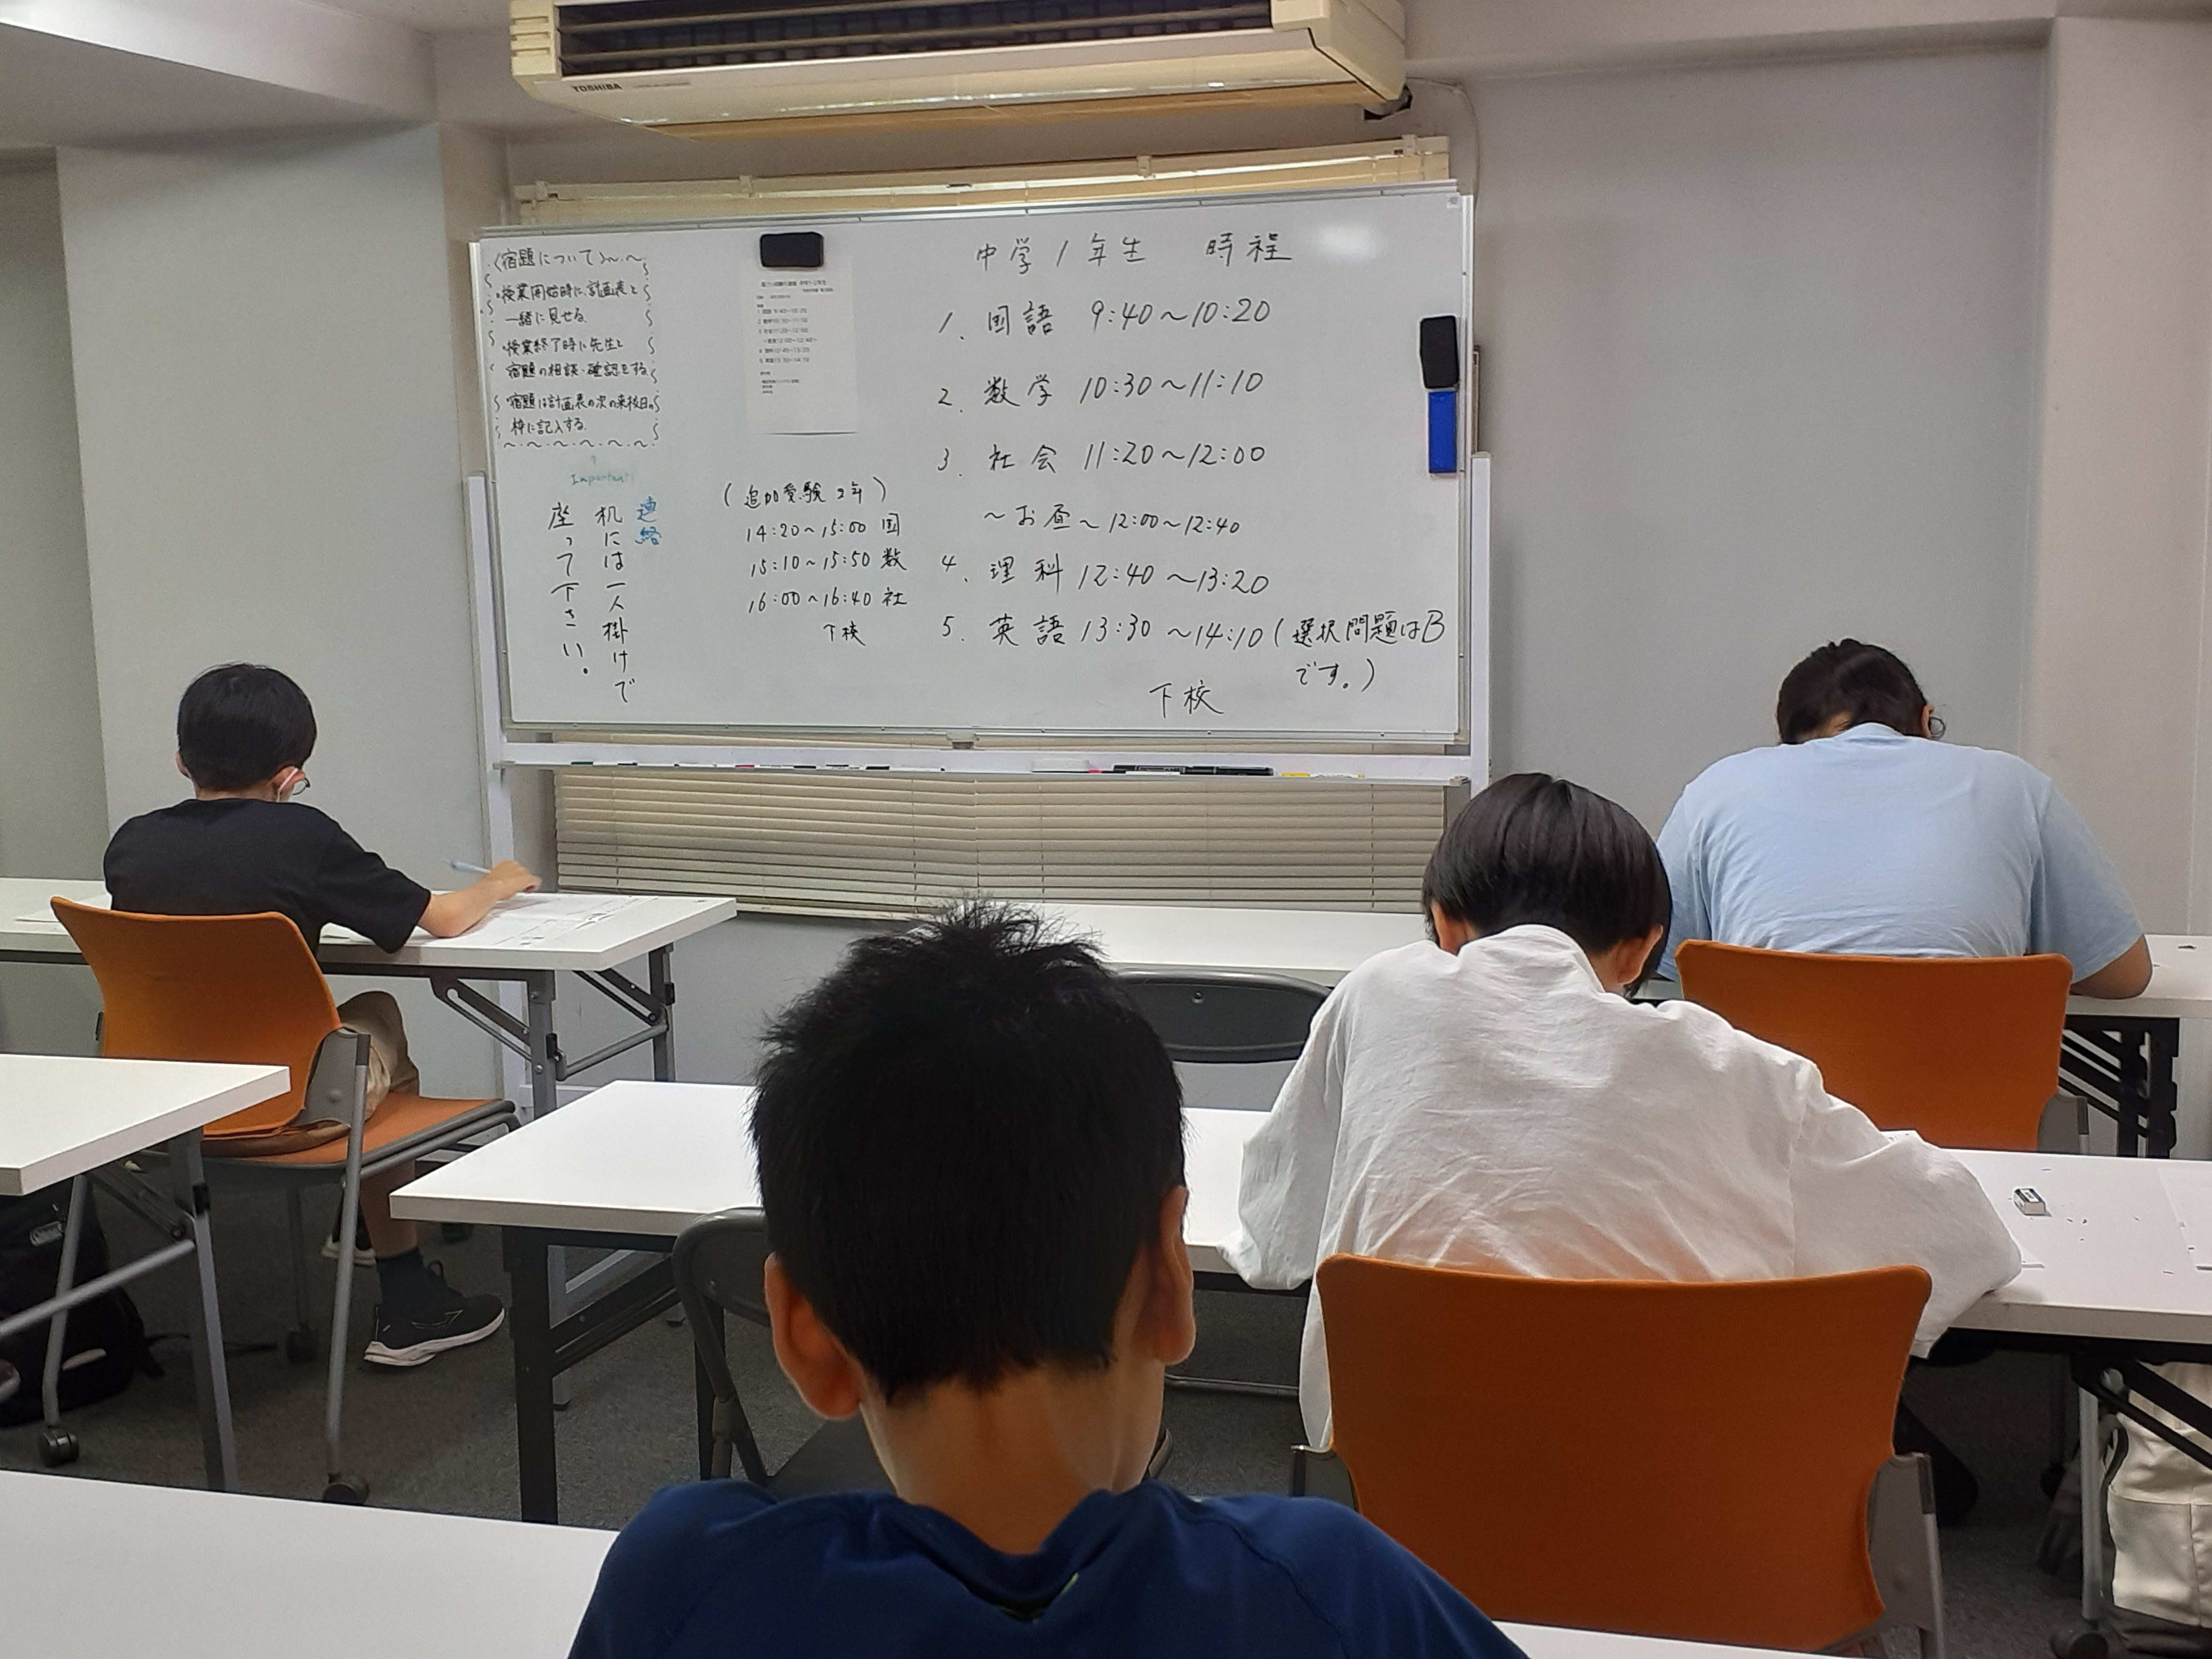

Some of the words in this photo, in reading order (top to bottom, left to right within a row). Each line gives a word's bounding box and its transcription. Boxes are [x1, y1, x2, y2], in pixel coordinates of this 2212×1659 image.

[571, 83, 622, 93] TOSHIBA
[976, 232, 1146, 275] 中学1年生
[1206, 232, 1292, 267] 時程
[988, 300, 1053, 336] 国語
[983, 373, 1052, 407] 数学
[989, 443, 1057, 474] 社会
[880, 547, 908, 571] 数
[990, 552, 1064, 594] 理科
[594, 505, 638, 703] 机には一人掛けで
[881, 586, 908, 607] 社
[989, 612, 1066, 646] 英語
[1149, 679, 1224, 719] 下校
